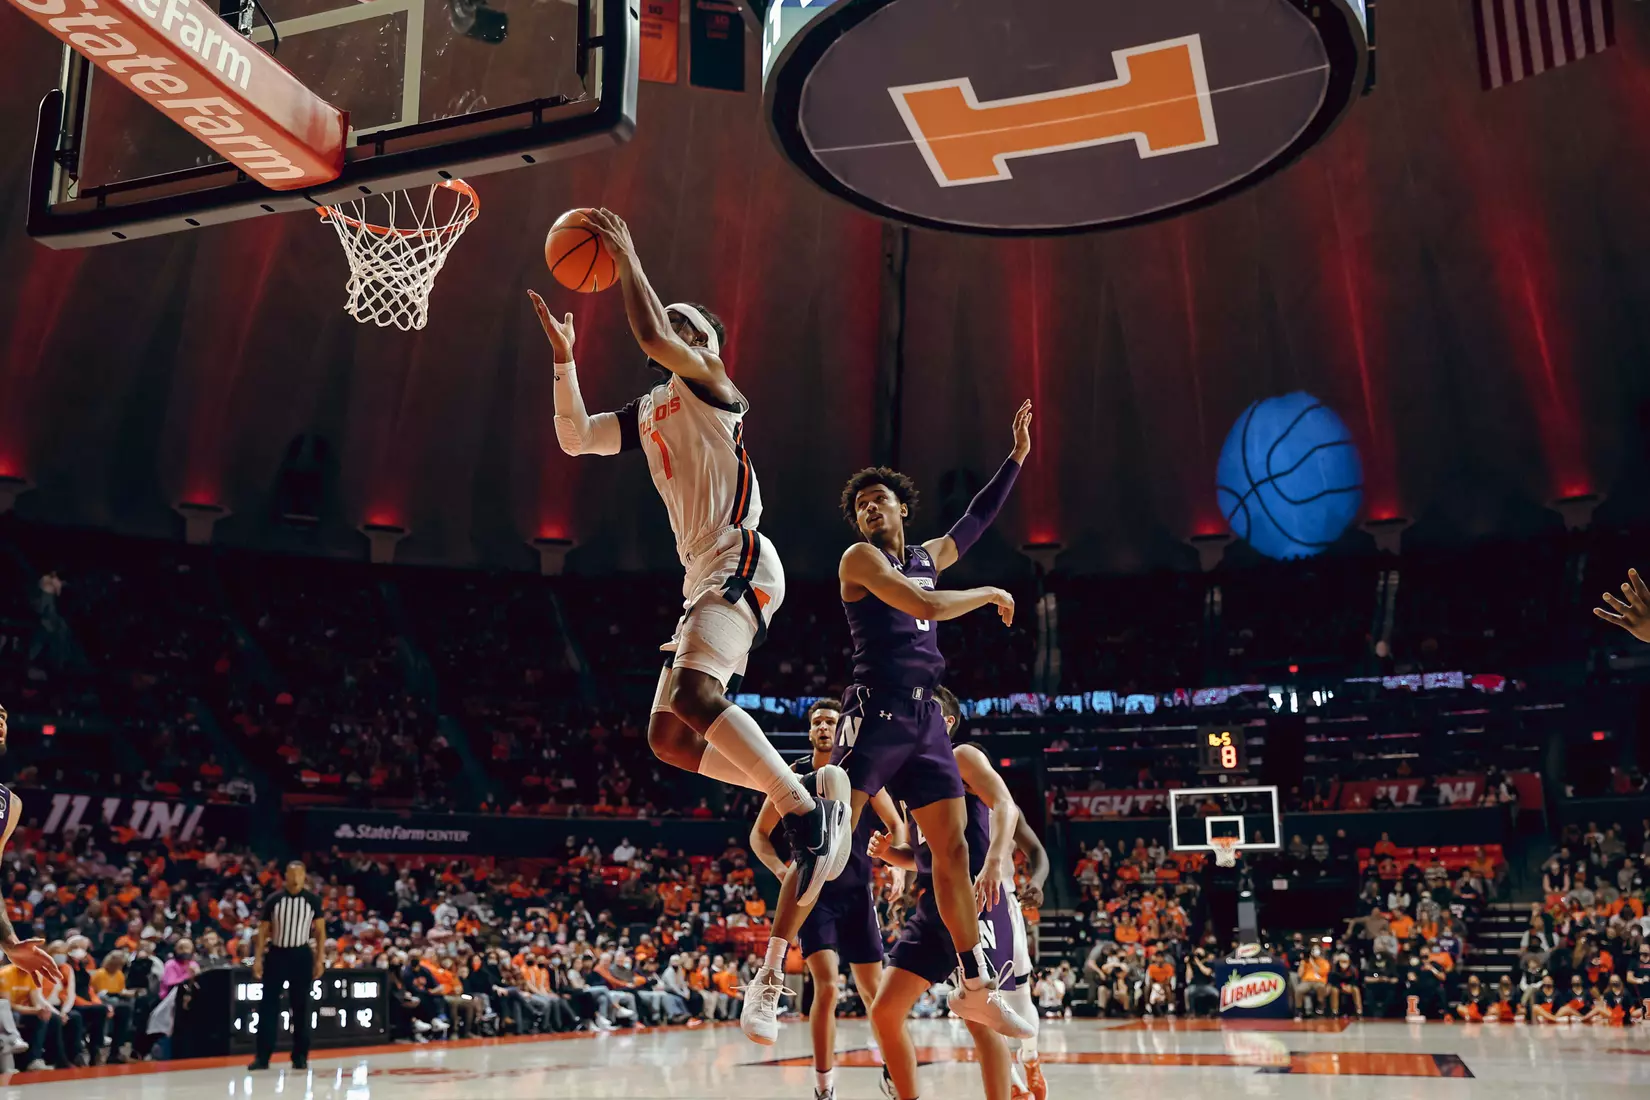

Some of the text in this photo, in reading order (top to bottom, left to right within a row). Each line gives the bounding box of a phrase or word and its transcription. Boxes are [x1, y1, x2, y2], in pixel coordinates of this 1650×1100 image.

[650, 430, 673, 480] 1
[838, 715, 863, 748] N
[1220, 745, 1238, 769] 8
[425, 829, 471, 843] CENTER
[978, 919, 997, 949] N
[1222, 979, 1279, 1007] LIBMAN
